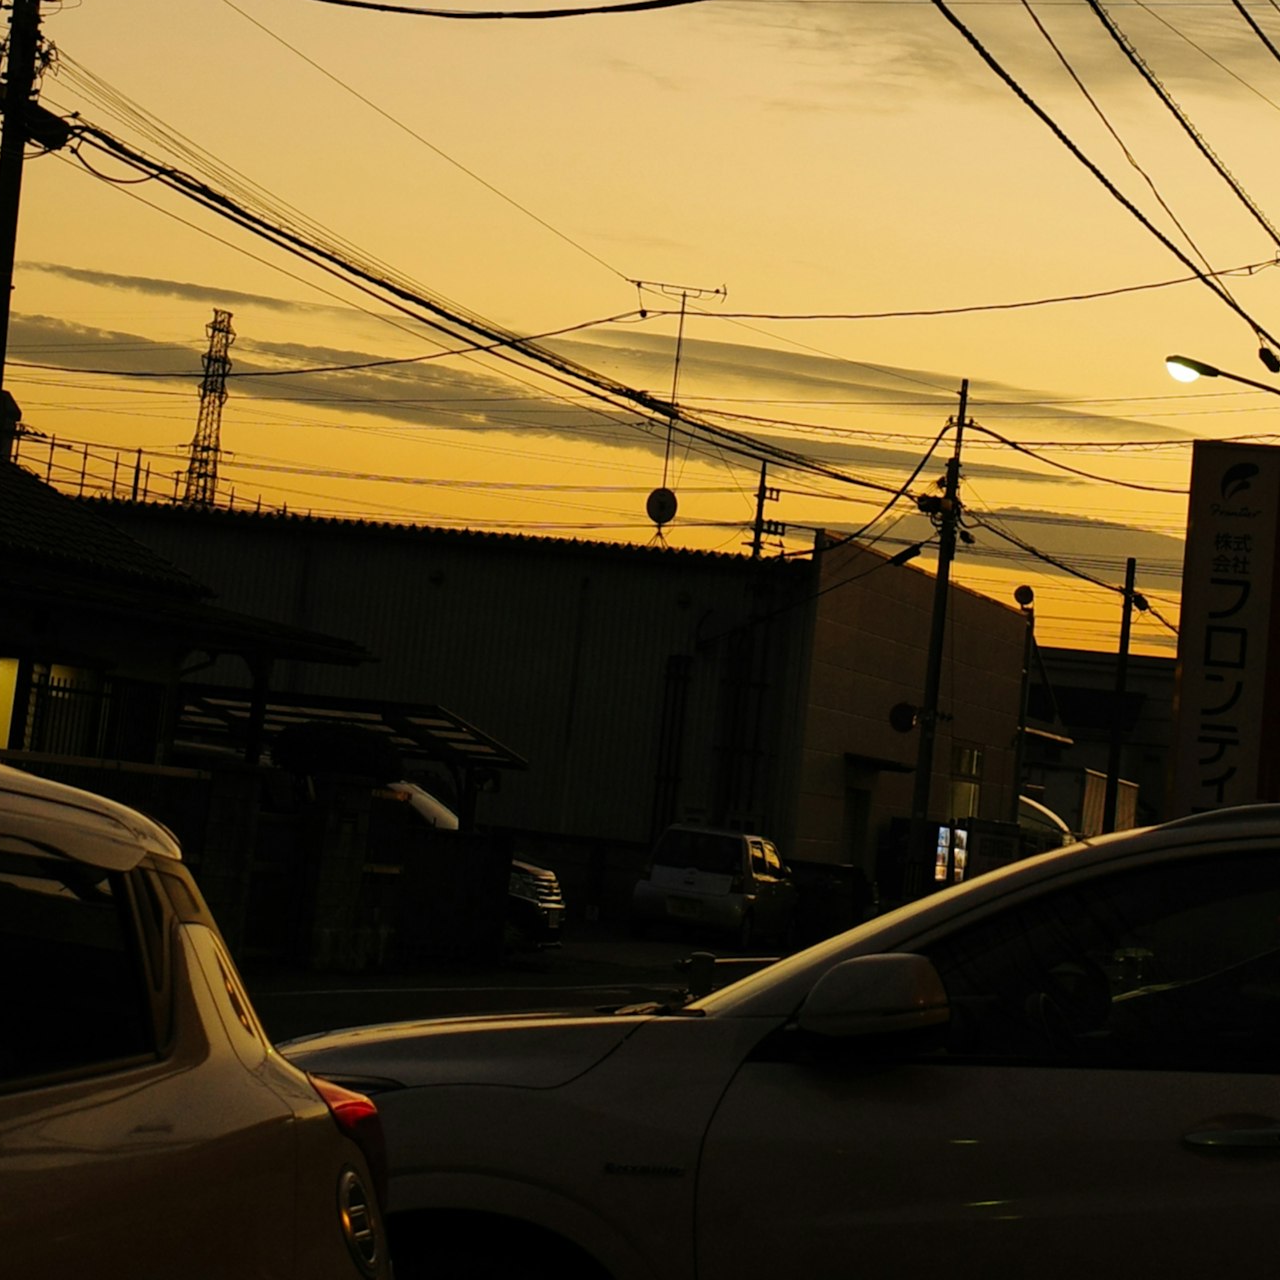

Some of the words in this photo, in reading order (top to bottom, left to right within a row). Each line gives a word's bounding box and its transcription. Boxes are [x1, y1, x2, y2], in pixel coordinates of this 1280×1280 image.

[1214, 533, 1253, 553] 株式
[1212, 554, 1251, 575] 会社
[1191, 578, 1251, 813] フロンティ
